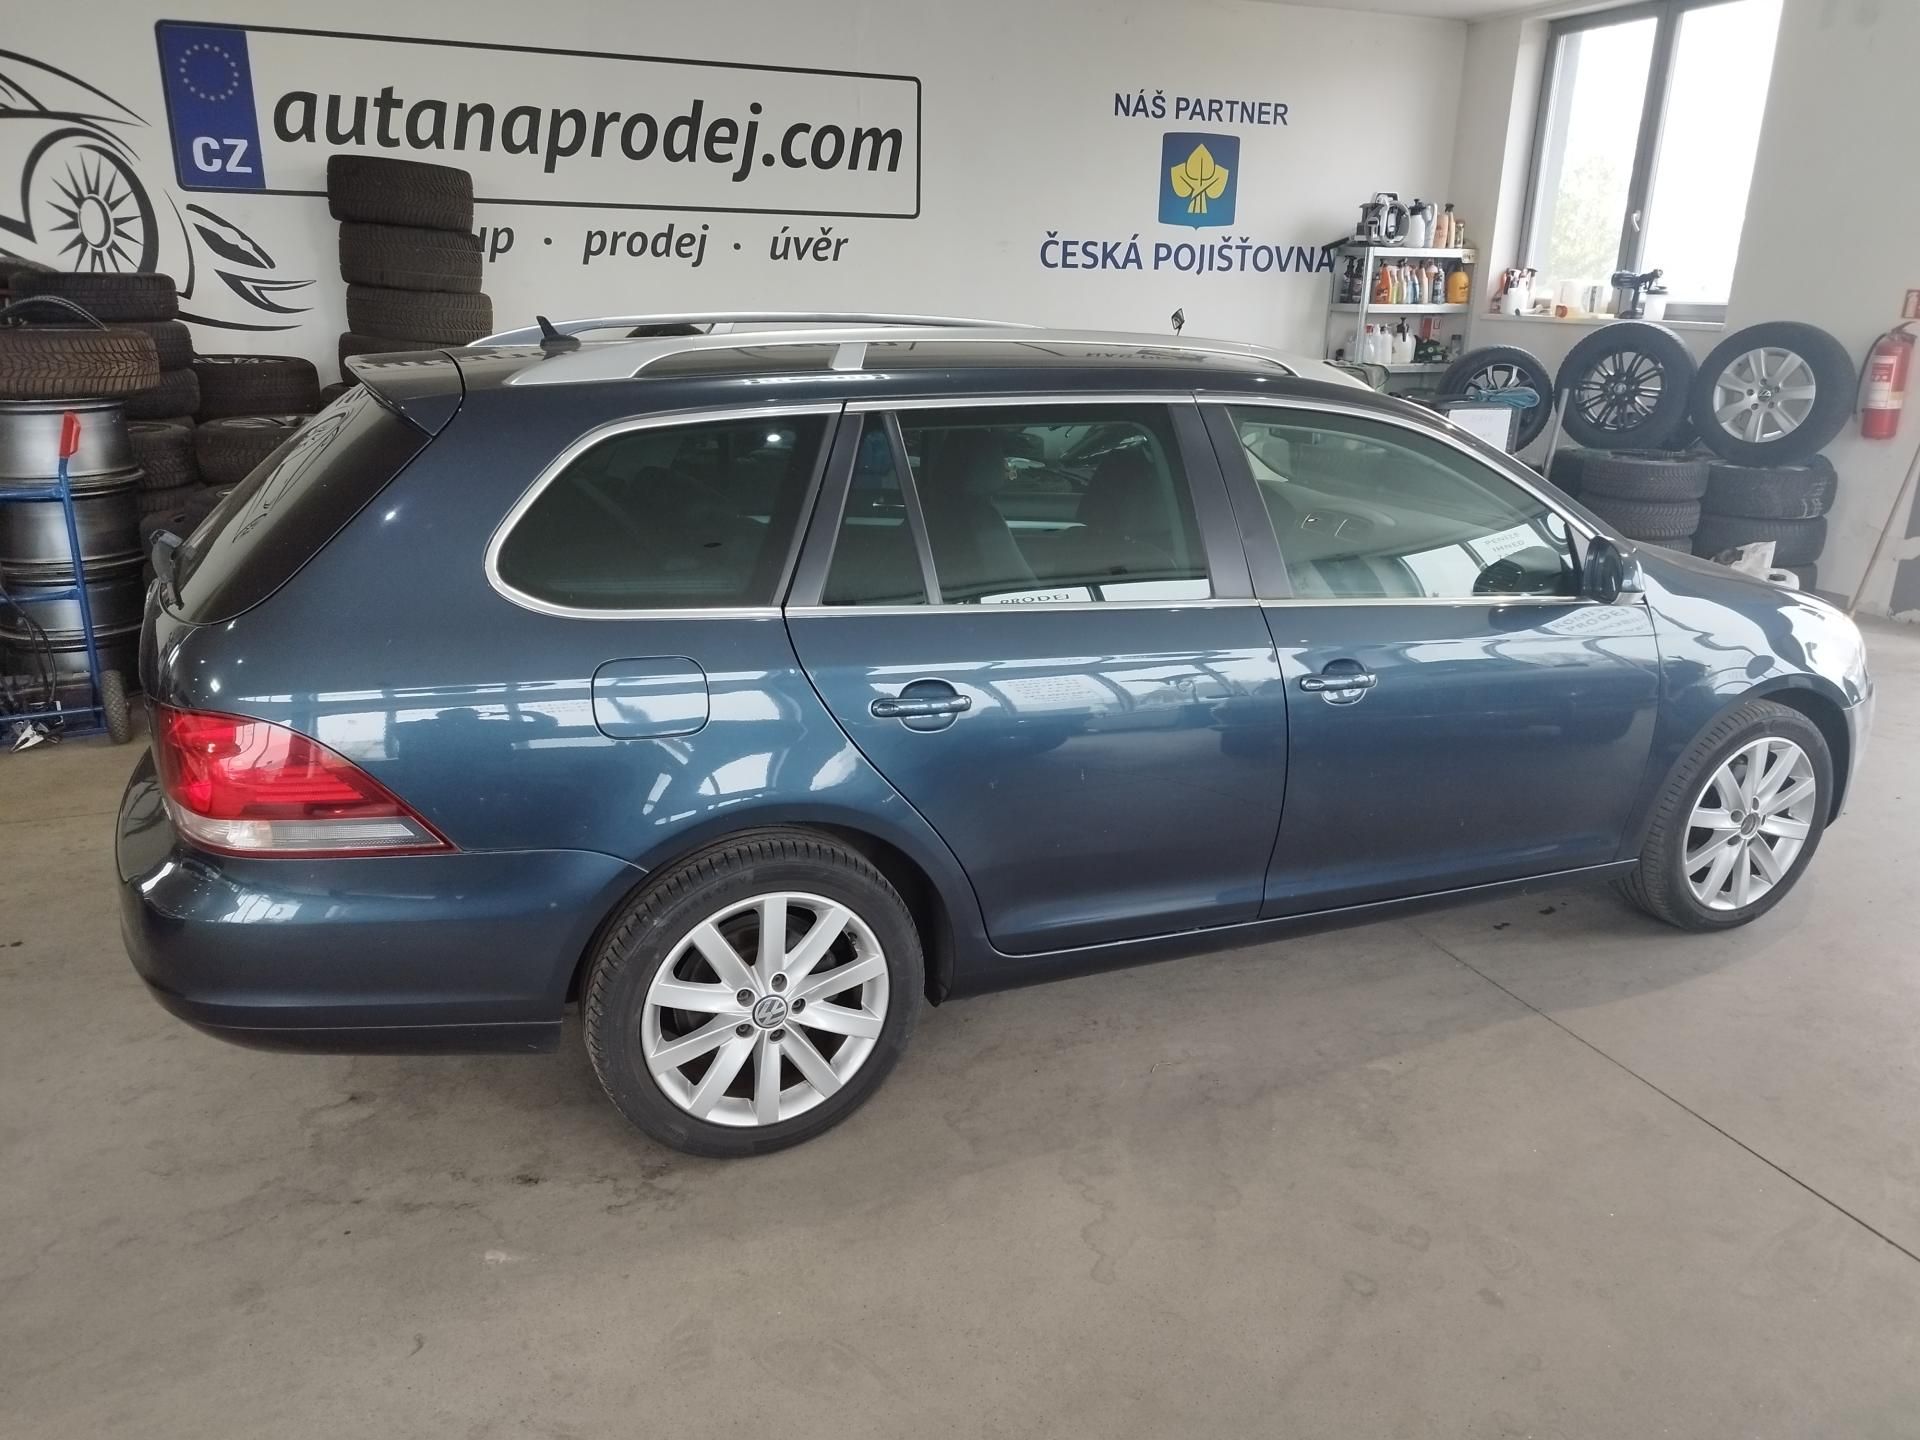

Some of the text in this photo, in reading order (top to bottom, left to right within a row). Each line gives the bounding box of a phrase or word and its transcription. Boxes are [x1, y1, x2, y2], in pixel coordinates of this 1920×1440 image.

[1114, 89, 1289, 126] NÁŠ PARTNER
[192, 136, 253, 174] CZ
[273, 85, 904, 183] autanaprodej.com
[582, 223, 710, 268] prodej
[769, 225, 850, 262] úvěr
[1040, 230, 1335, 275] ČESKÁ POJIŠŤOVNA
